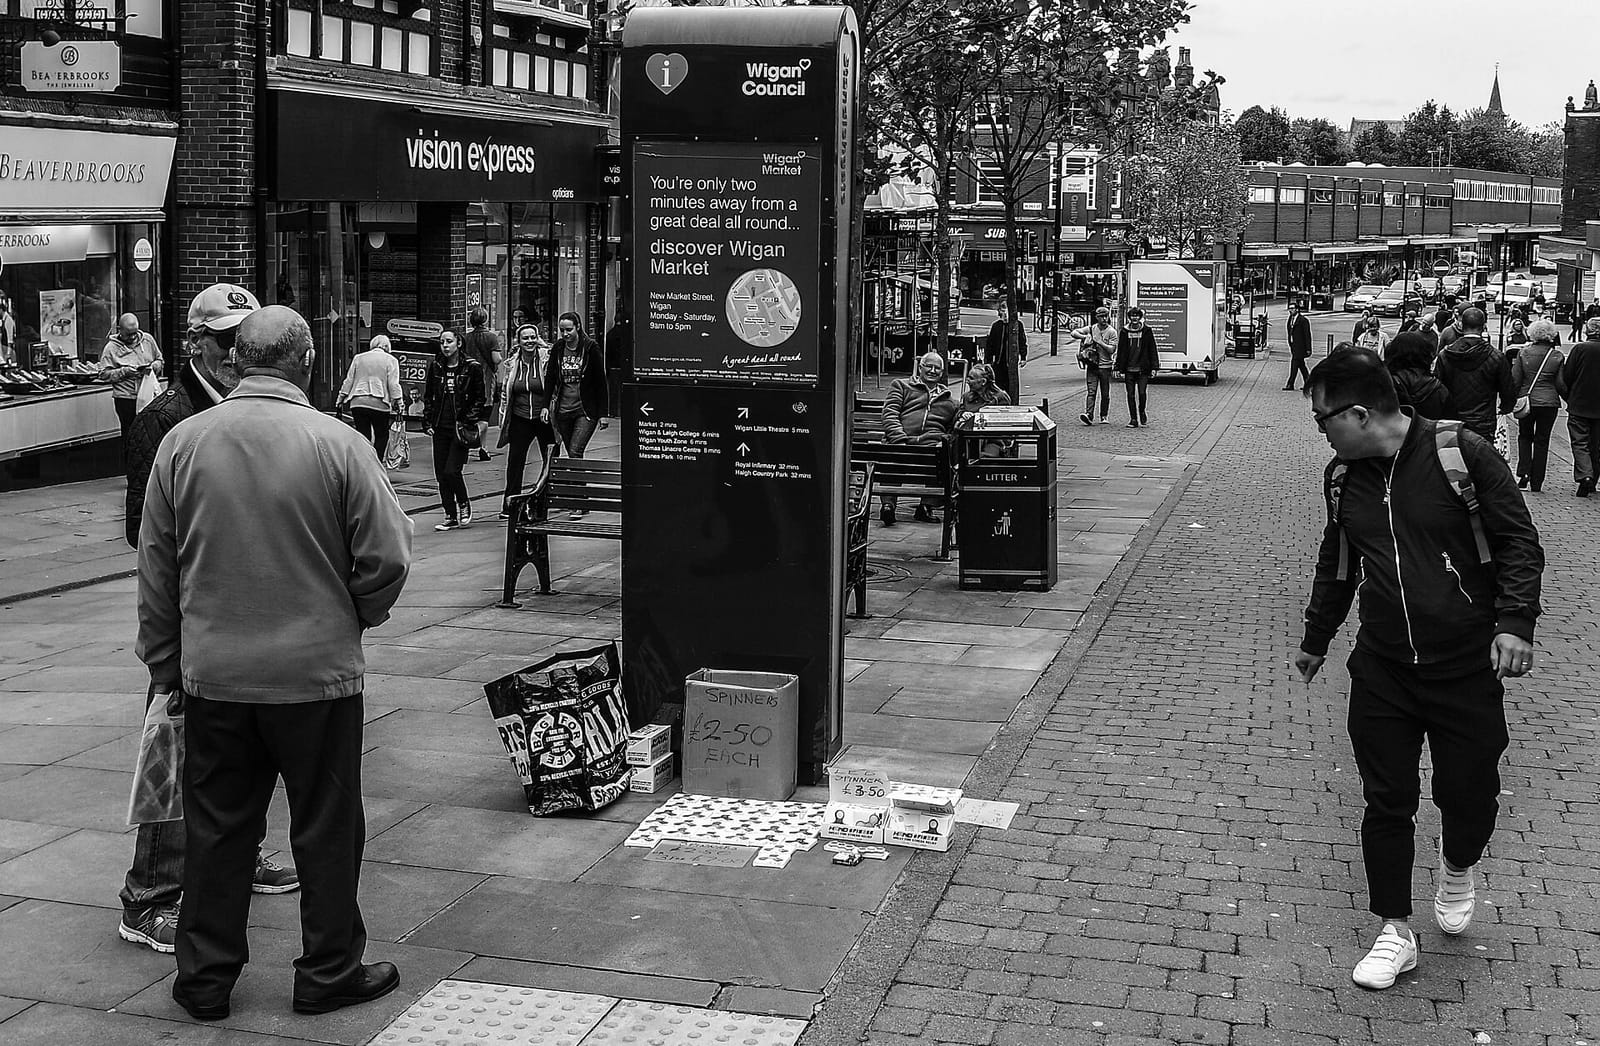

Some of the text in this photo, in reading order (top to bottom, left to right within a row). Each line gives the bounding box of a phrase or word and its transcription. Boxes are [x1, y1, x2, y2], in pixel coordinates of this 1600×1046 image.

[32, 70, 110, 80] BEAERBROOKS
[745, 62, 802, 82] Wigan
[741, 81, 806, 96] Council
[406, 128, 535, 180] vision express
[763, 153, 800, 166] Wigan
[0, 152, 146, 185] BEAVERBROOKS
[608, 164, 621, 175] vis
[762, 165, 802, 176] Market
[650, 176, 757, 193] You're only two
[552, 187, 574, 200] opticians
[650, 194, 798, 213] minutes away from a
[650, 214, 800, 231] great deal all round...
[0, 233, 51, 248] ERBROOKS
[650, 239, 786, 260] discover Wigan
[650, 258, 710, 275] Market
[650, 292, 716, 302] New Market Street,
[650, 302, 672, 311] Wigan
[650, 311, 678, 321] Monday
[683, 313, 717, 323] Saturday,
[650, 322, 692, 331] 9am to 5pm
[400, 355, 407, 366] 2
[729, 355, 750, 368] great
[768, 353, 779, 363] all
[735, 424, 752, 432] Wigan
[735, 461, 751, 469] Royal
[752, 470, 774, 478] Country
[985, 473, 1018, 481] LITTER
[705, 688, 778, 708] SPINNERS
[533, 720, 550, 748] BAG
[560, 716, 581, 739] FOR
[546, 751, 574, 766] LIFE
[704, 748, 760, 769] EACH
